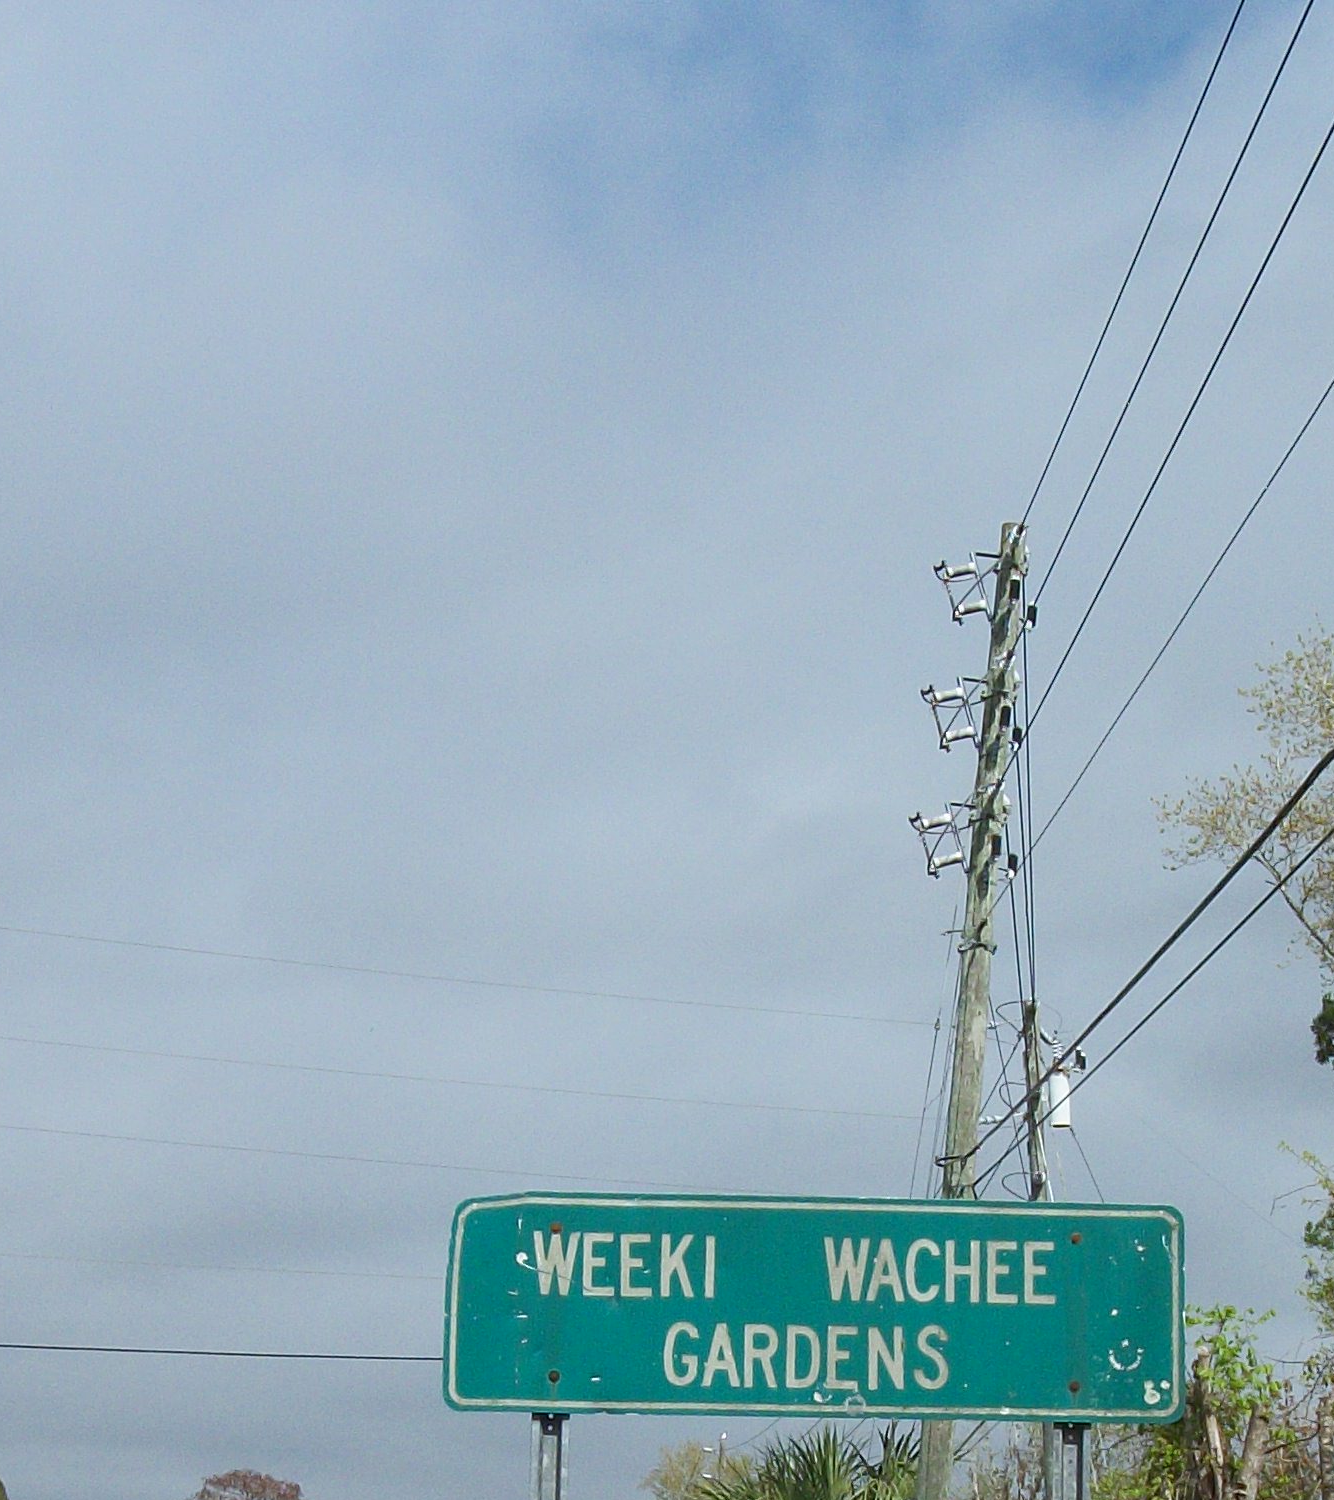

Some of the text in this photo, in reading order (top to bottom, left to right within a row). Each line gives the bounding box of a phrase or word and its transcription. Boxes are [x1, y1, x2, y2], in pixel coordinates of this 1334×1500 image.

[533, 1231, 1057, 1305] WEEKI WACHEE
[663, 1321, 950, 1391] GARDENS
